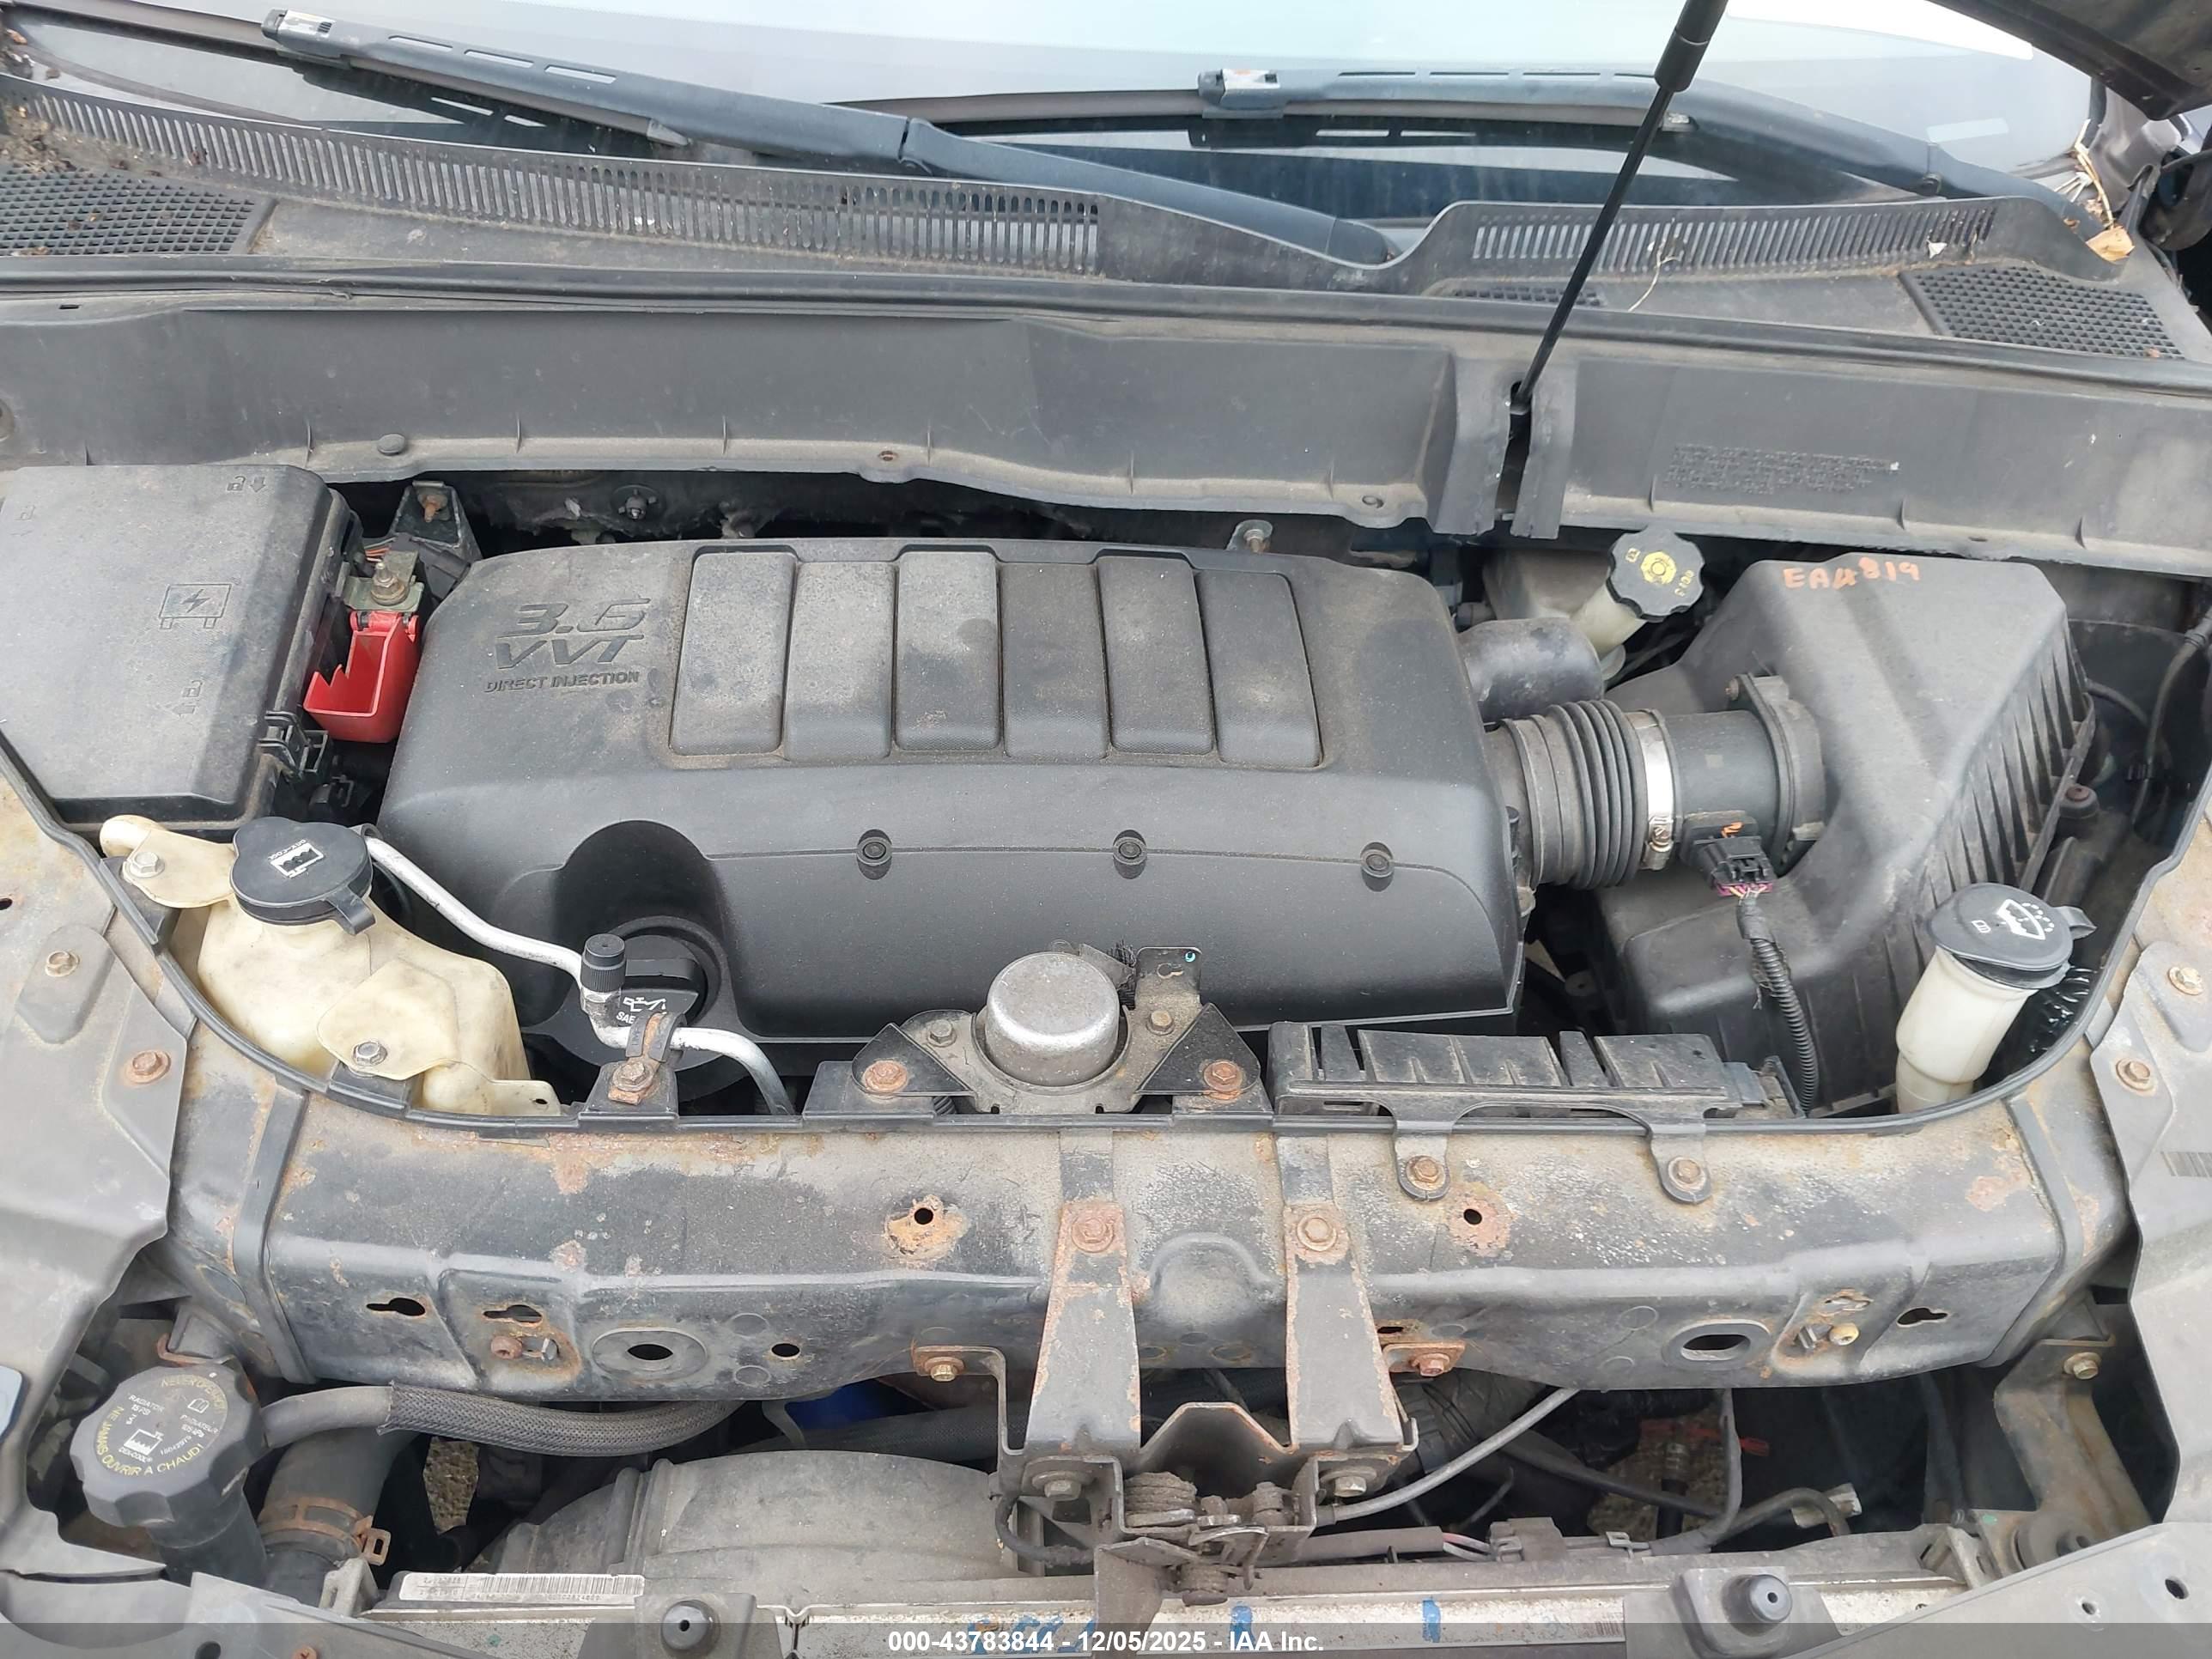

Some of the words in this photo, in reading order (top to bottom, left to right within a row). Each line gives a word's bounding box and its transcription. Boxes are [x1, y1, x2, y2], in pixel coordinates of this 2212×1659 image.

[495, 598, 651, 638] 3.6
[495, 635, 644, 669] VVT
[484, 677, 548, 692] DIRECT
[550, 671, 640, 688] INJECTION
[616, 1012, 636, 1024] SAE
[128, 1395, 165, 1413] RADIATOR
[101, 1455, 142, 1476] OUVRIR
